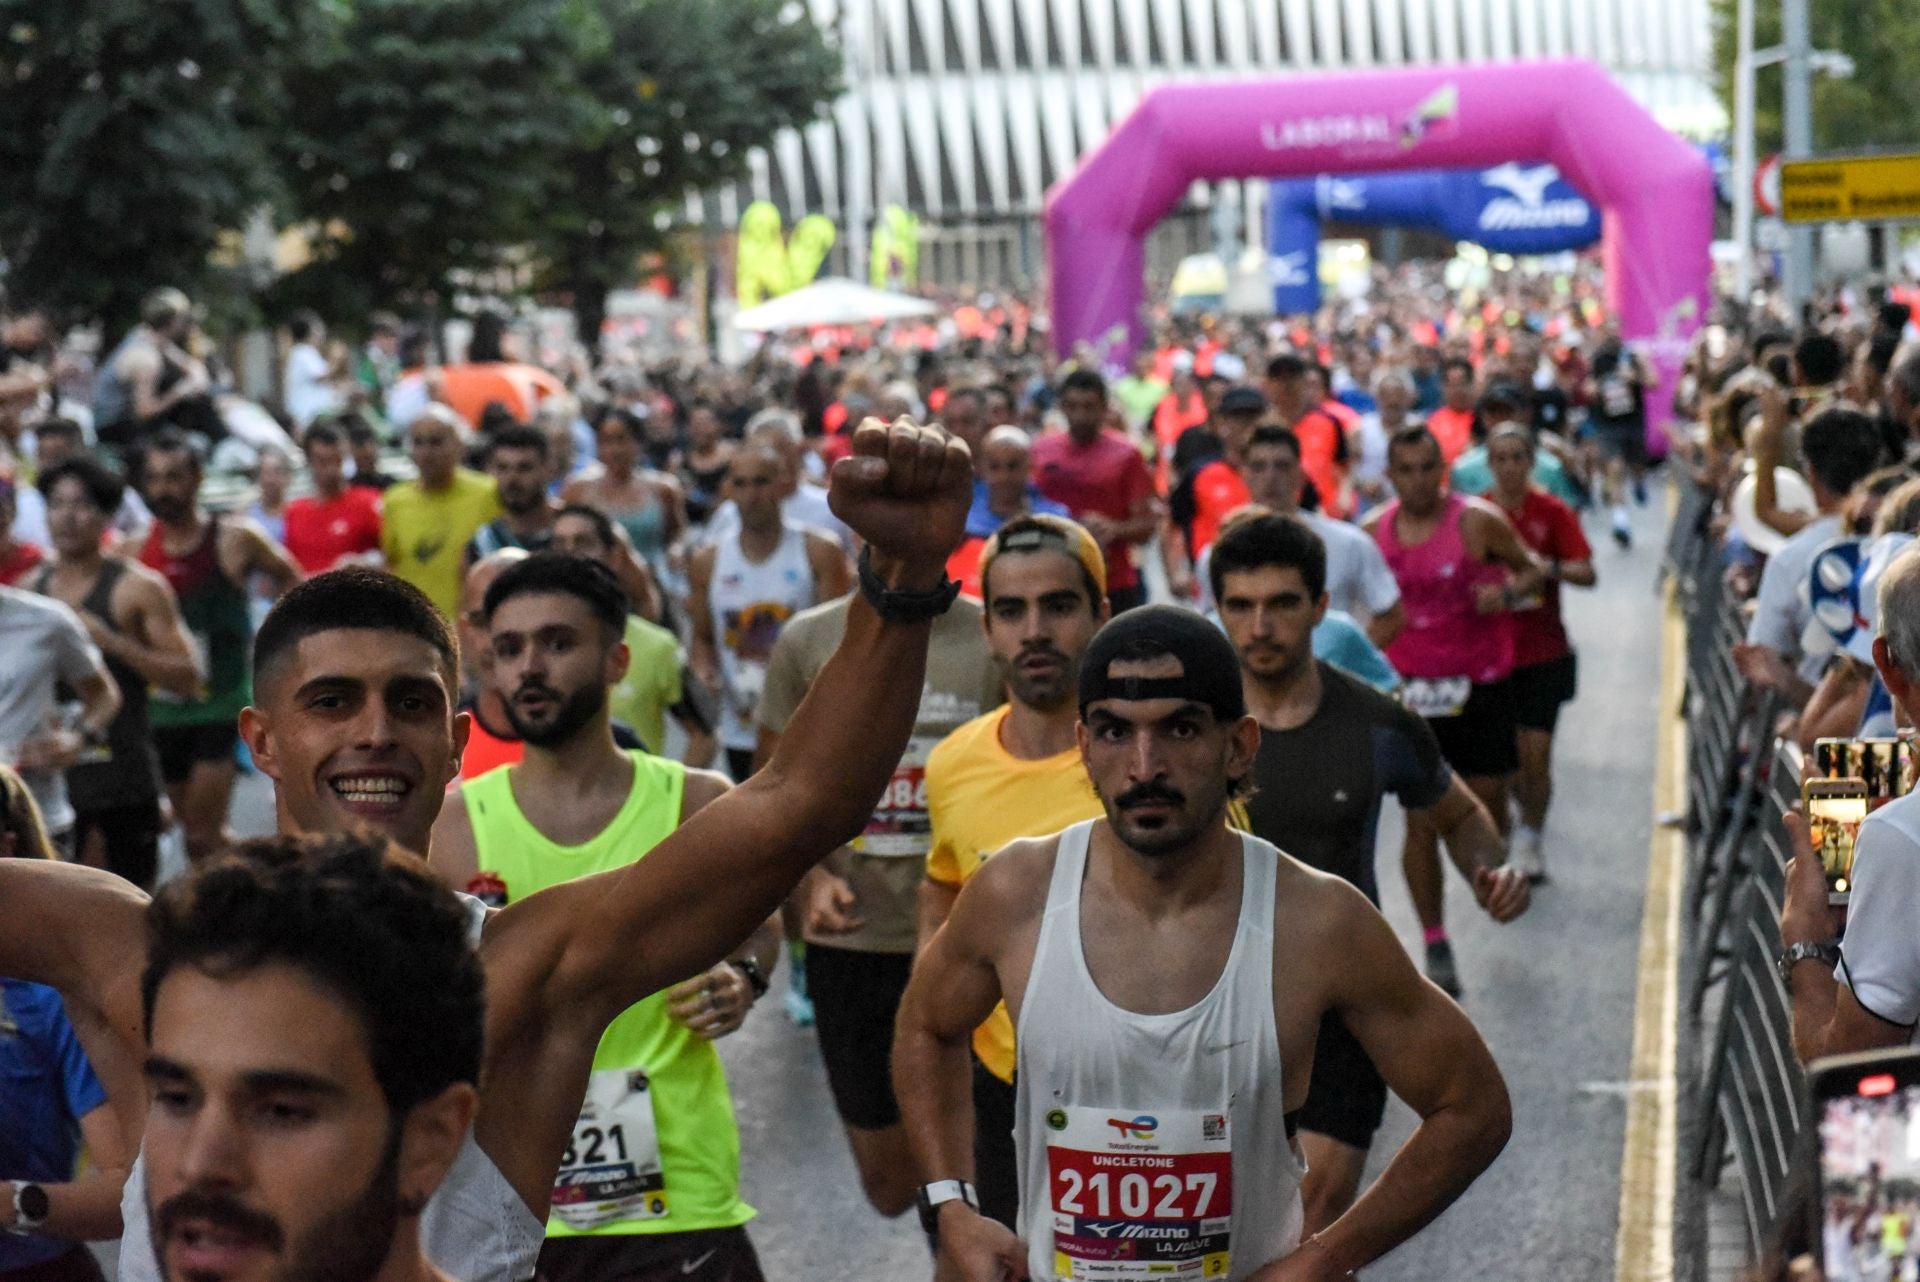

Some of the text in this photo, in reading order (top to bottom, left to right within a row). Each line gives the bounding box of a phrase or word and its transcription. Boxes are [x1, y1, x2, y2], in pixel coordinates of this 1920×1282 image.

[1093, 1155, 1175, 1168] UNCLETONE
[1058, 1168, 1218, 1218] 21027
[1119, 1225, 1190, 1239] MIZUNO
[1156, 1242, 1173, 1253] LA
